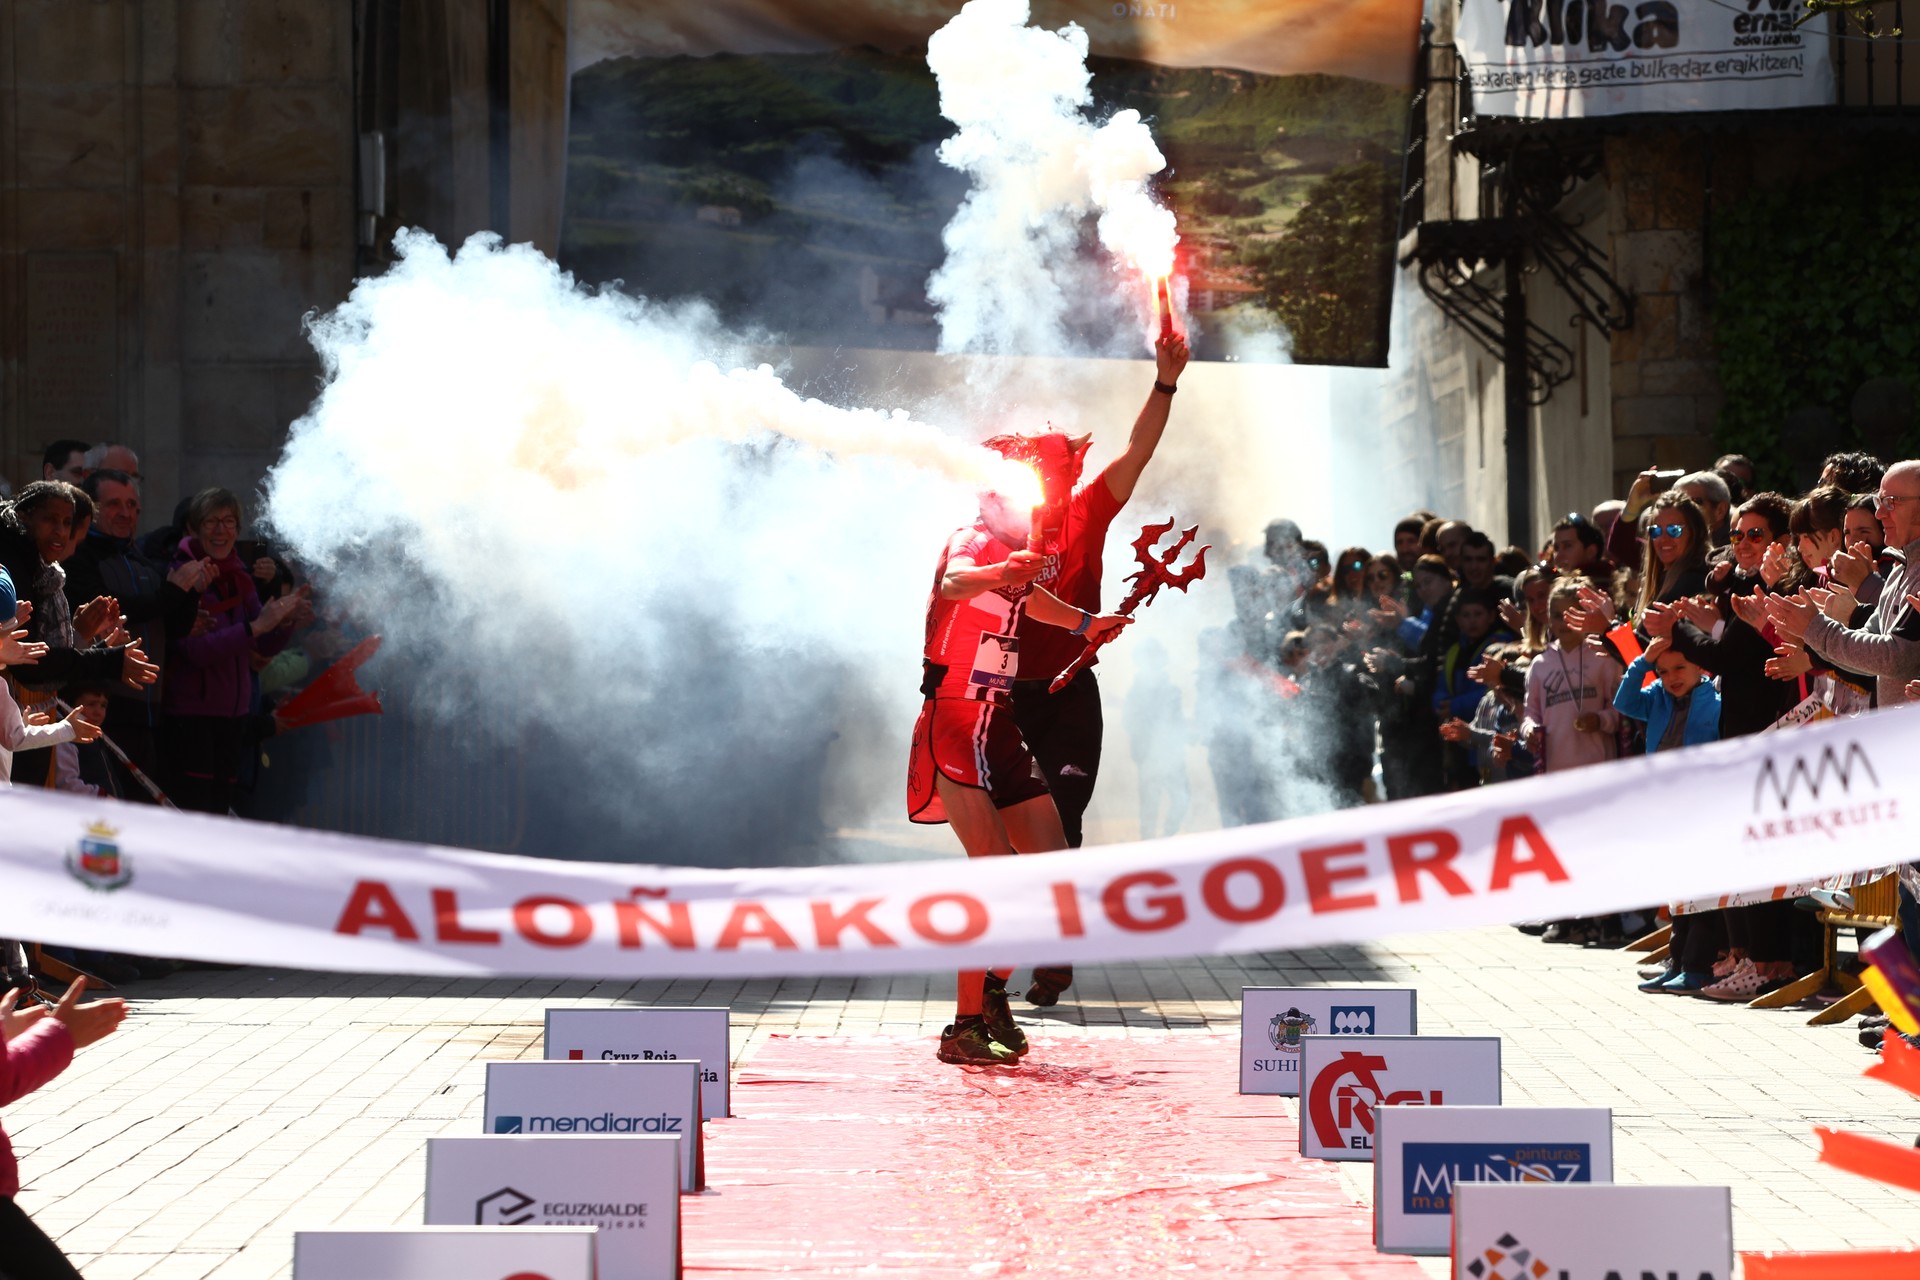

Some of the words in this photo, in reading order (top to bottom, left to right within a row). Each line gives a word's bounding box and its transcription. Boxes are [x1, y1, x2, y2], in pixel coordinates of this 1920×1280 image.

[1580, 62, 1626, 85] gazte
[1631, 57, 1712, 78] bulkadaz
[1714, 53, 1804, 74] eraikitzen!
[1001, 653, 1009, 669] 3
[335, 880, 990, 951] ALOÑAKO
[1050, 813, 1571, 939] IGOERA
[529, 1113, 682, 1132] mendiaraiz
[1515, 1147, 1581, 1162] pinturas
[543, 1203, 648, 1216] EGUZKIALDE
